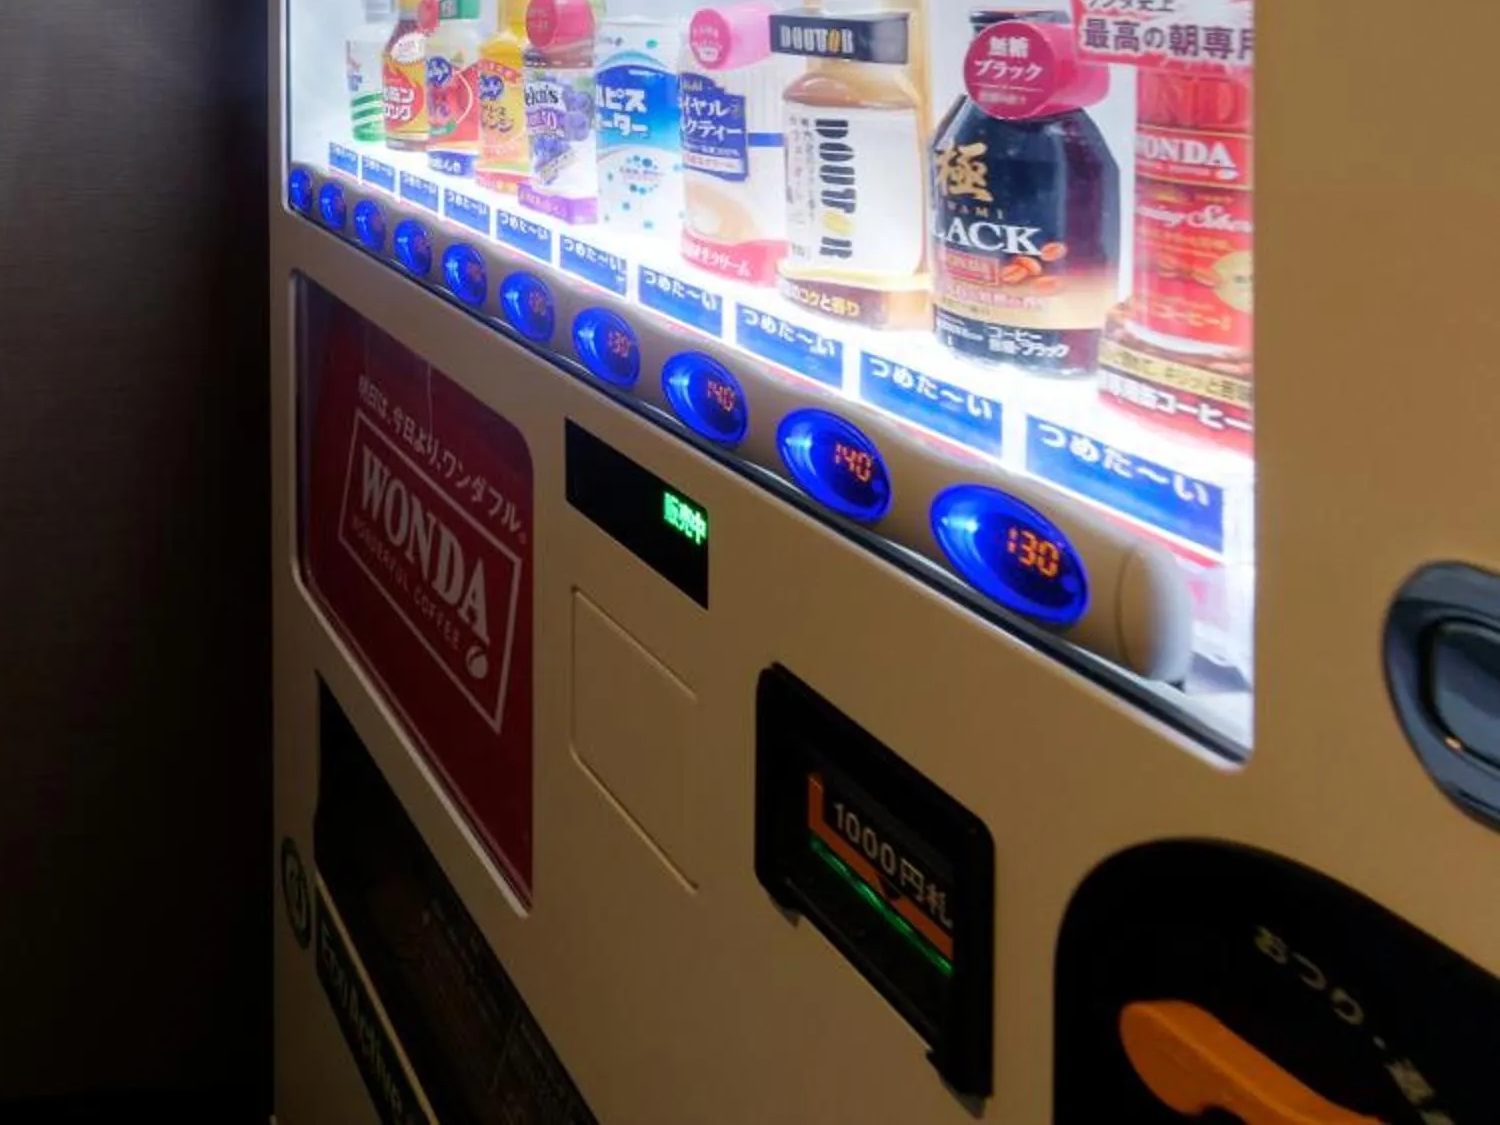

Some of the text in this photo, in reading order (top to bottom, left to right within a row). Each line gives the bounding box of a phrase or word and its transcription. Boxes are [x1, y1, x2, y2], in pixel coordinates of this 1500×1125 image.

[974, 58, 1044, 82] ブラック
[835, 442, 873, 484] 140
[361, 445, 490, 644] WONDA
[1006, 525, 1061, 580] 130
[833, 802, 953, 929] 1000円札
